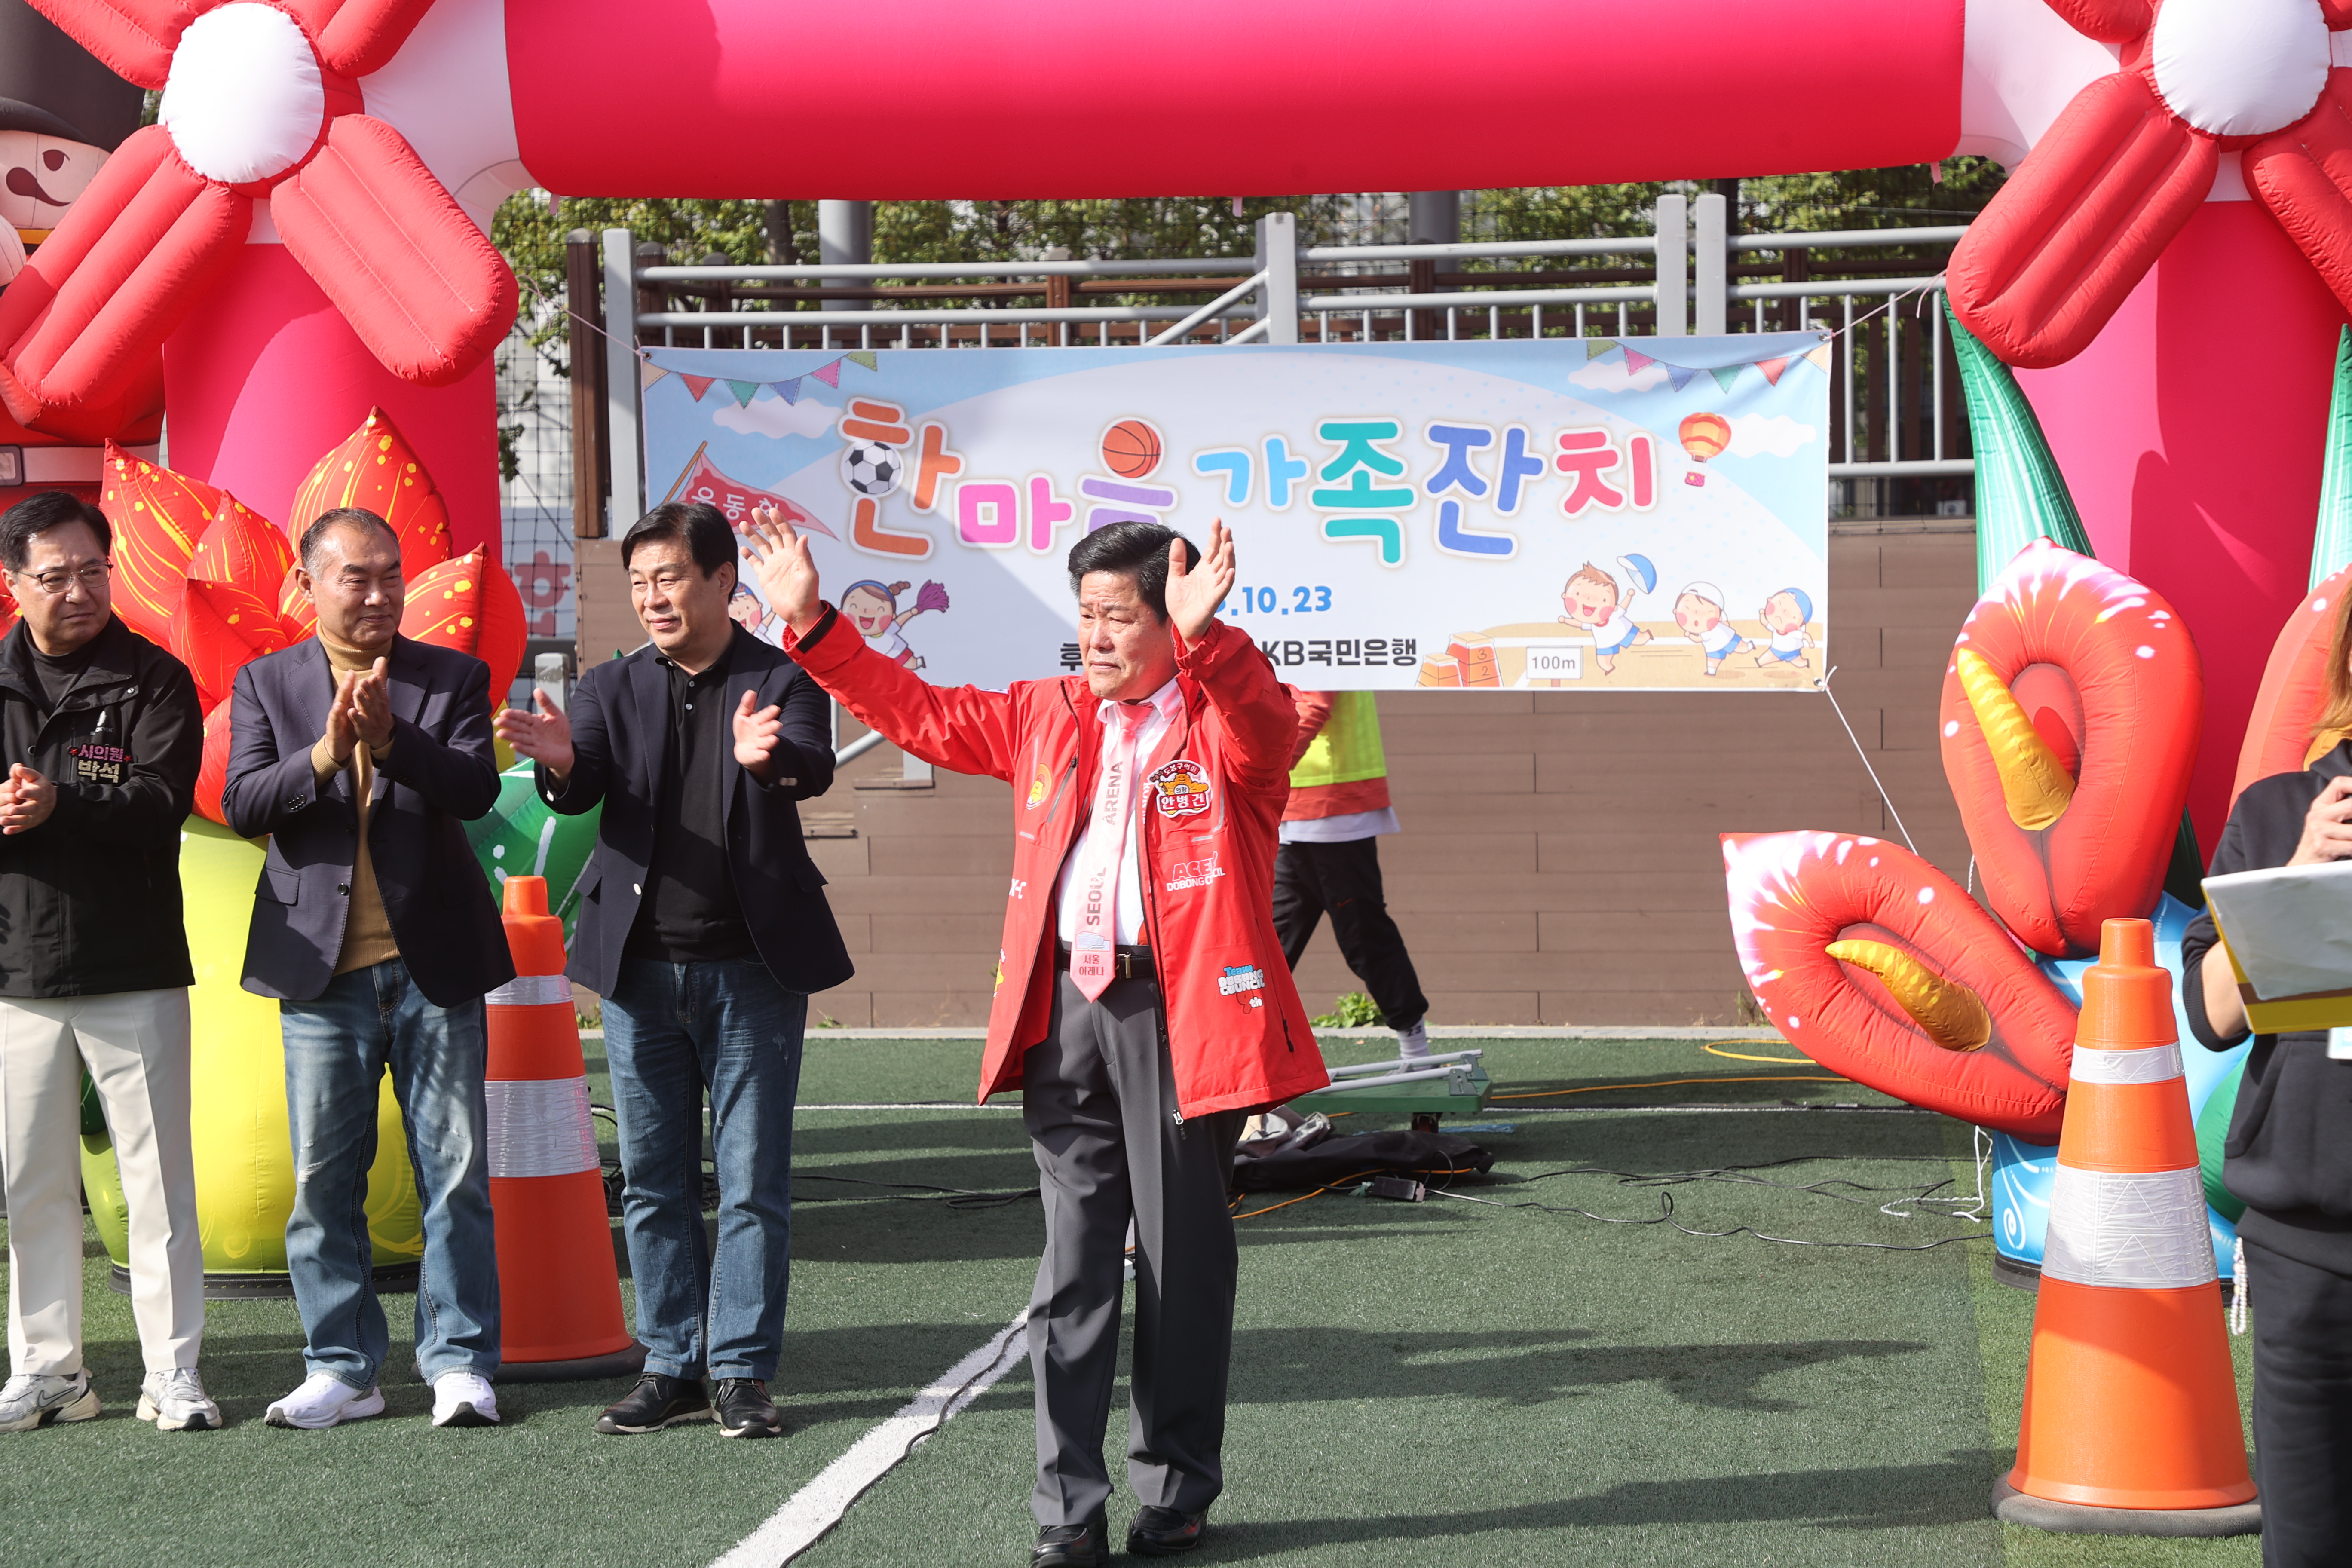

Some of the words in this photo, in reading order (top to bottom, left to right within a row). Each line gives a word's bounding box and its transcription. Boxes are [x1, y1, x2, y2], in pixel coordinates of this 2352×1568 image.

[1194, 420, 1652, 564] 가족잔치
[1262, 638, 1417, 666] KB국민은행
[1477, 649, 1487, 660] 3
[1532, 656, 1576, 669] 100m
[1482, 666, 1490, 677] 2
[78, 744, 124, 762] 시의원
[78, 759, 120, 784] 박석
[1163, 763, 1198, 775] 도봉구의회
[1161, 793, 1205, 810] 안병건
[1087, 867, 1106, 926] SEOUL
[1102, 761, 1123, 825] ARENA
[1166, 876, 1205, 892] DOBONG
[1083, 955, 1100, 964] 서울
[1079, 966, 1105, 976] 아레나
[1224, 965, 1253, 977] Team
[1220, 978, 1265, 996] COUNCIL
